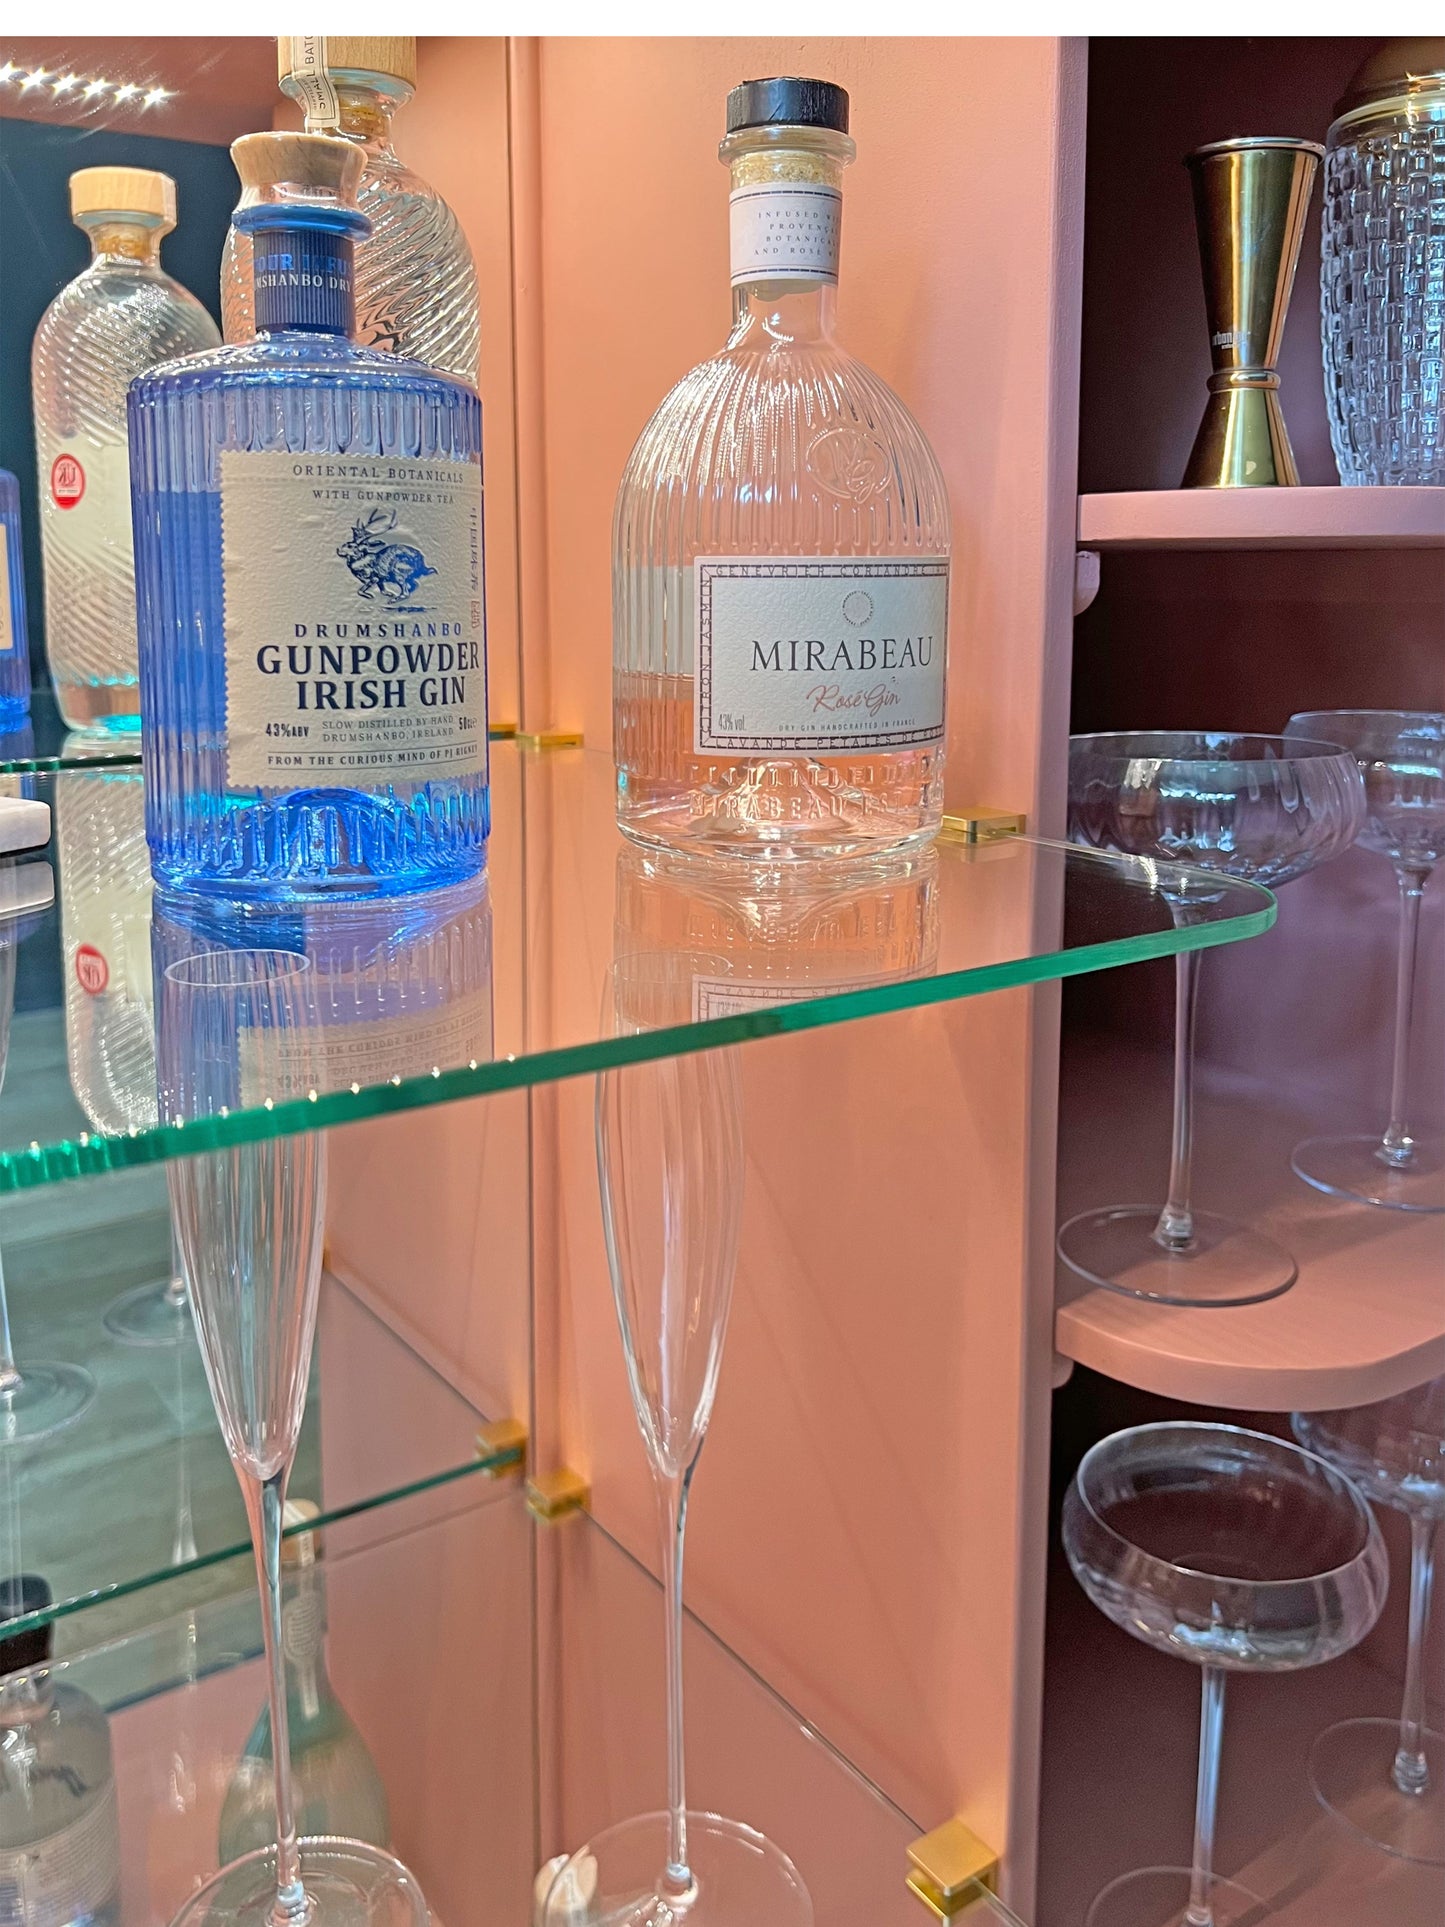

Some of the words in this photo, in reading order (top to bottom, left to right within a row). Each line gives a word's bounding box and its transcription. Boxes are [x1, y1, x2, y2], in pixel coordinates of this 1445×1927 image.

[758, 211, 819, 219] INFUSED
[754, 247, 779, 255] AND
[293, 464, 380, 478] ORIENTAL
[388, 468, 464, 483] BOTANICALS
[312, 489, 350, 500] WITH
[357, 491, 432, 503] GUNPOWDER
[437, 495, 455, 504] TEA
[294, 623, 462, 638] DRUMSHANBO
[256, 641, 480, 675] GUNPOWDER
[750, 636, 933, 671] MIRABEAU
[297, 679, 407, 711] IRISH
[419, 675, 466, 707] GIN
[806, 685, 861, 713] Rosé
[863, 683, 901, 718] Gin
[322, 720, 354, 730] SLOW
[358, 718, 413, 729] DISTILLED
[416, 718, 427, 727] BY
[430, 715, 454, 725] HAND
[779, 724, 795, 732] DRY
[800, 724, 816, 732] GIN
[821, 721, 878, 731] HANDCRAFTED
[892, 719, 916, 728] FRANCE
[412, 727, 454, 739] IRELAND
[716, 739, 801, 749] LAVANDE
[268, 756, 303, 765] FROM
[309, 756, 334, 765] THE
[340, 754, 393, 765] CURIOUS
[397, 752, 426, 762] MIND
[430, 750, 441, 760] OF
